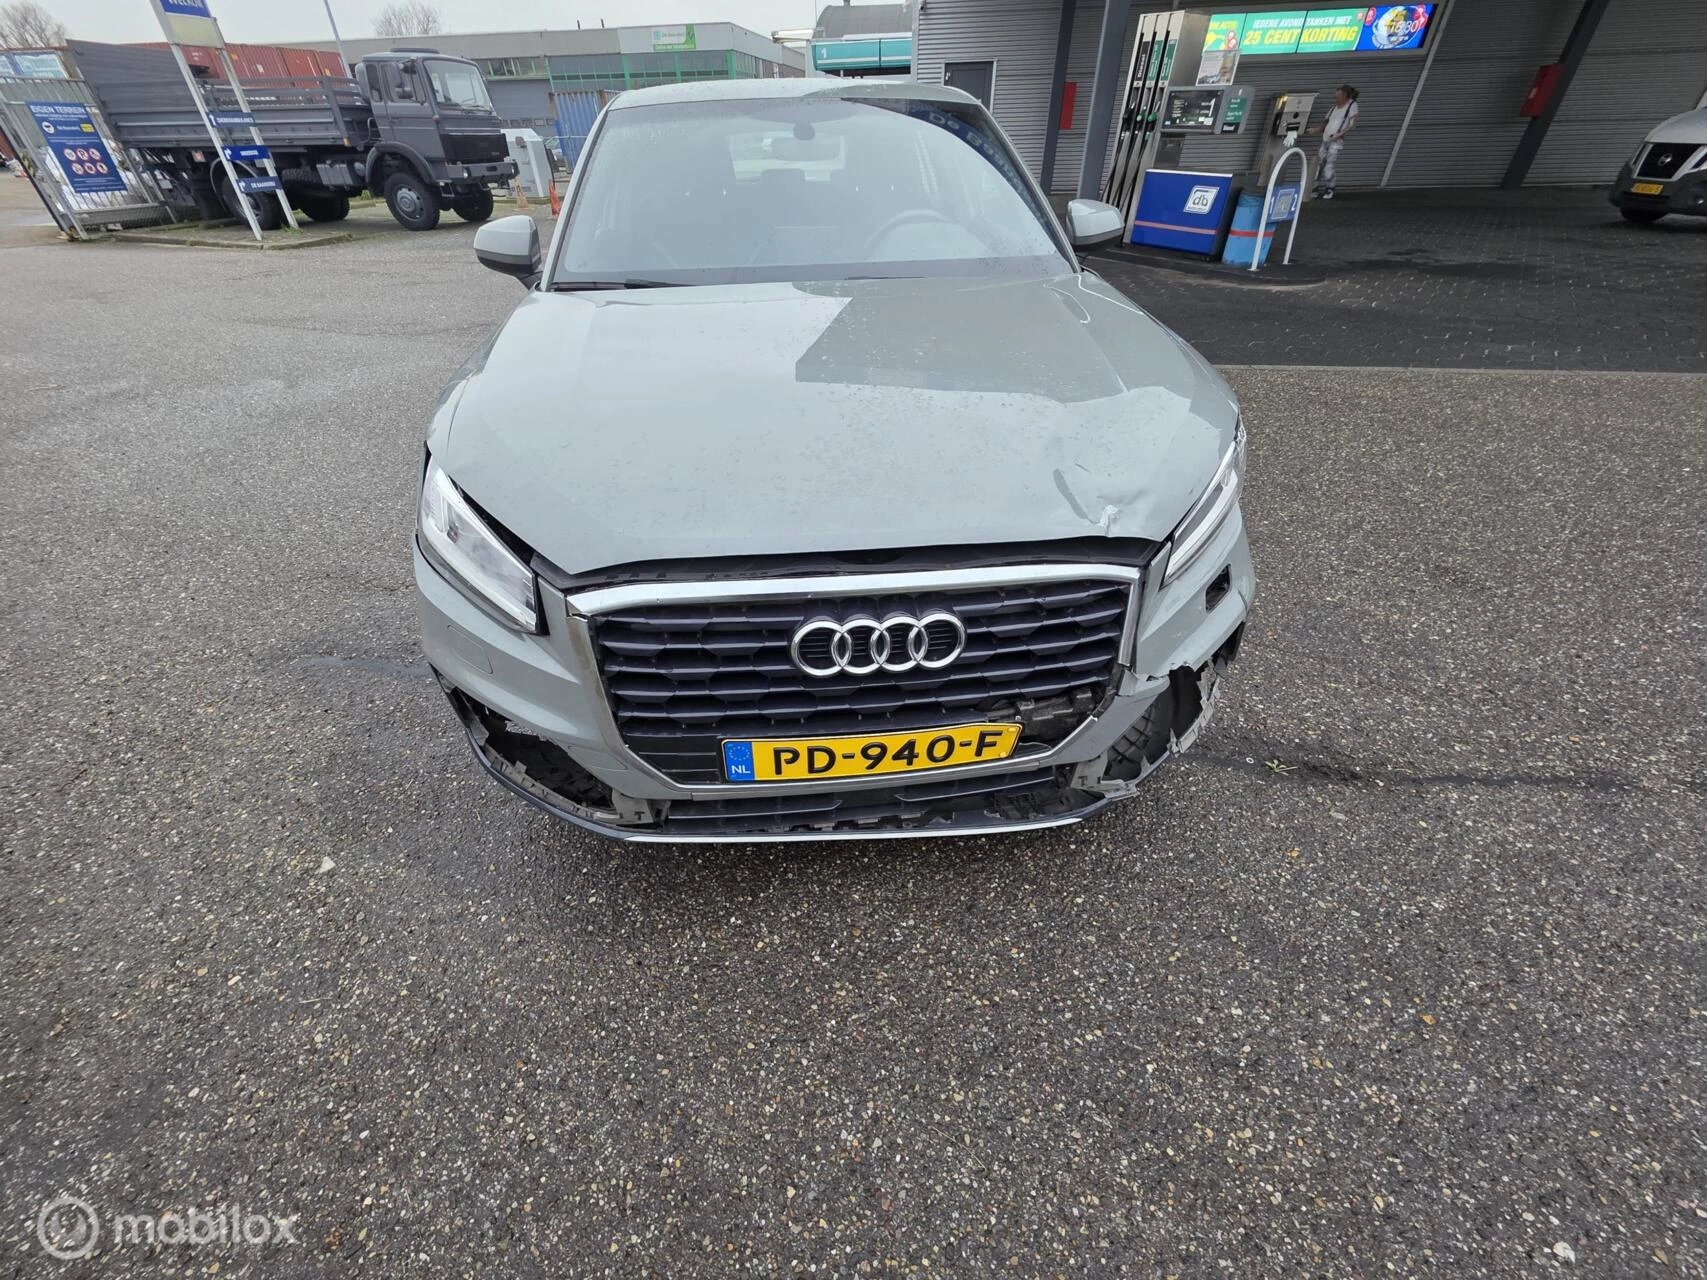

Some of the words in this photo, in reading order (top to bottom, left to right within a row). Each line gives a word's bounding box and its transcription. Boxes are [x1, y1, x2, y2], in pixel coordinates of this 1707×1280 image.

[1253, 19, 1279, 28] IEDERE
[1279, 18, 1304, 27] AVOND
[1305, 17, 1334, 27] TANKEN
[1335, 16, 1352, 25] MET
[1245, 31, 1261, 45] 25
[1264, 29, 1300, 44] CENT
[1301, 26, 1358, 43] KORTING
[1137, 54, 1146, 78] Diesel
[29, 105, 55, 113] EIGEN
[1269, 196, 1275, 214] 1
[1291, 193, 1298, 211] 2
[773, 729, 1003, 776] PD-940-F
[731, 764, 750, 774] NL
